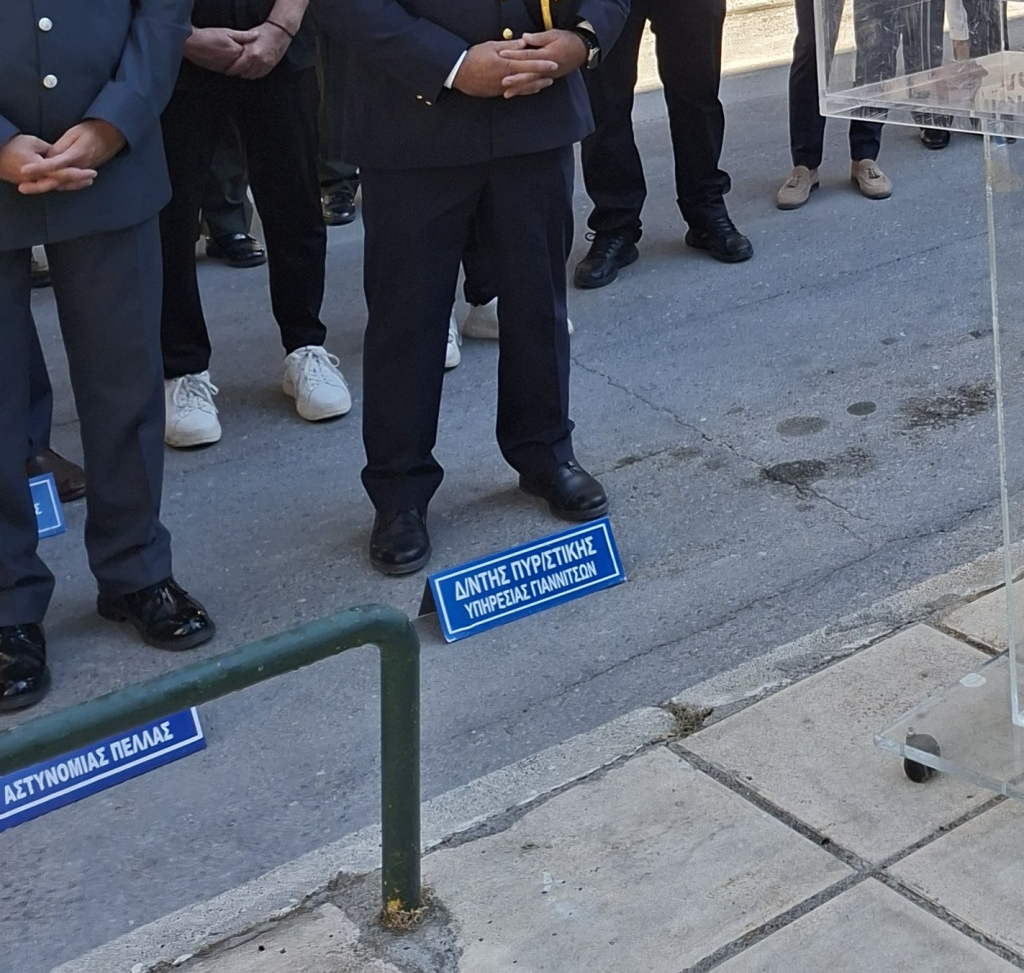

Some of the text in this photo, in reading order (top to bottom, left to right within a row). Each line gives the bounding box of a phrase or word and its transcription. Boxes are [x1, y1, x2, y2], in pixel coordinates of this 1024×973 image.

[455, 536, 598, 602] Δ/ΝΤΗΣ ΠΥΡ/ΣΤΙΚΗΣ
[464, 560, 597, 619] ΥΠΗΡΕΣΙΑΣ ΓΙΑΝΝΙΤΣΩΝ
[4, 720, 174, 806] ΑΣΤΥΝΟΜΙΑΣ ΠΕΛΛΑΣ
